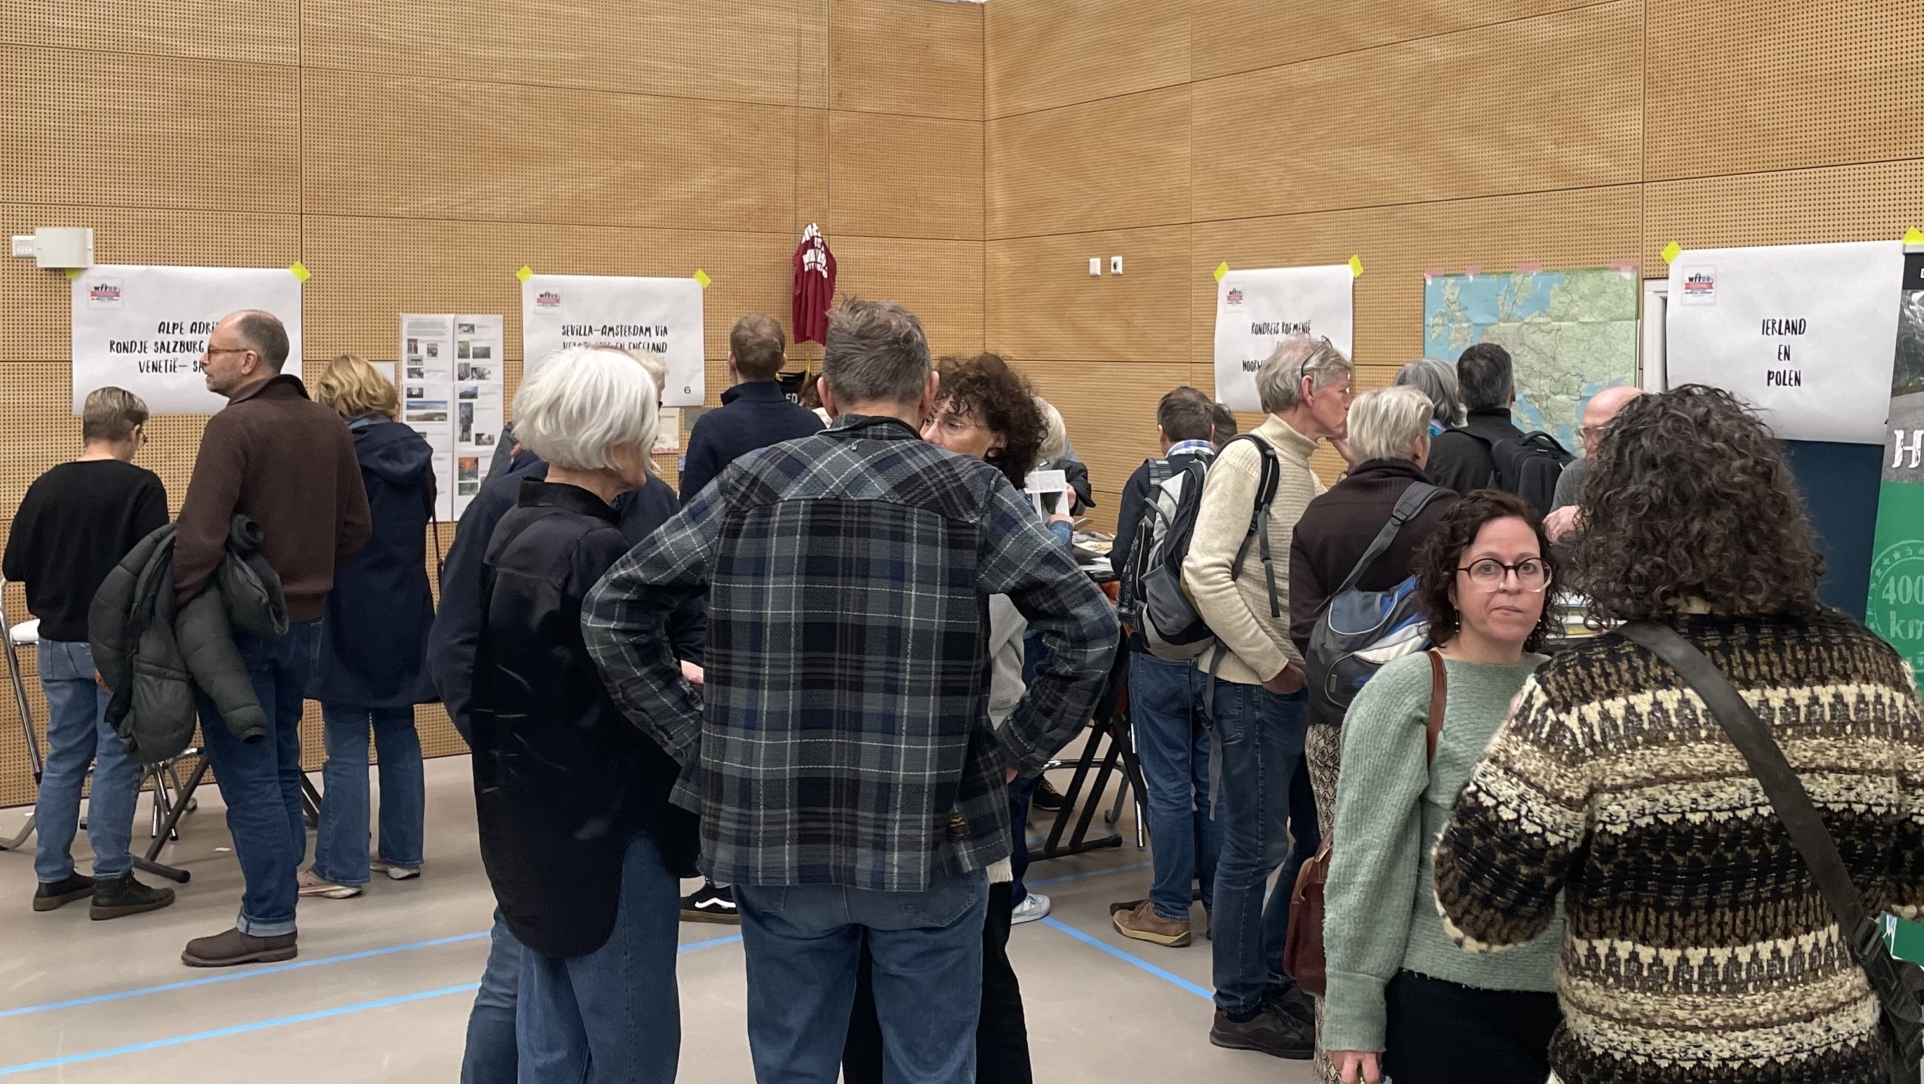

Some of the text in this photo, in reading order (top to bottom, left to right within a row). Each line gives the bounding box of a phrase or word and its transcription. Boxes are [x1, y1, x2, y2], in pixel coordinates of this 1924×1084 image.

[158, 321, 185, 335] ALPE
[1251, 321, 1280, 335] RONDREIS
[1761, 318, 1807, 336] IERLAND
[109, 340, 204, 354] RONDJE SALZBURG
[1777, 344, 1791, 361] EN
[1242, 359, 1266, 372] NOORW
[1766, 369, 1801, 387] POLEN
[683, 385, 692, 395] 6
